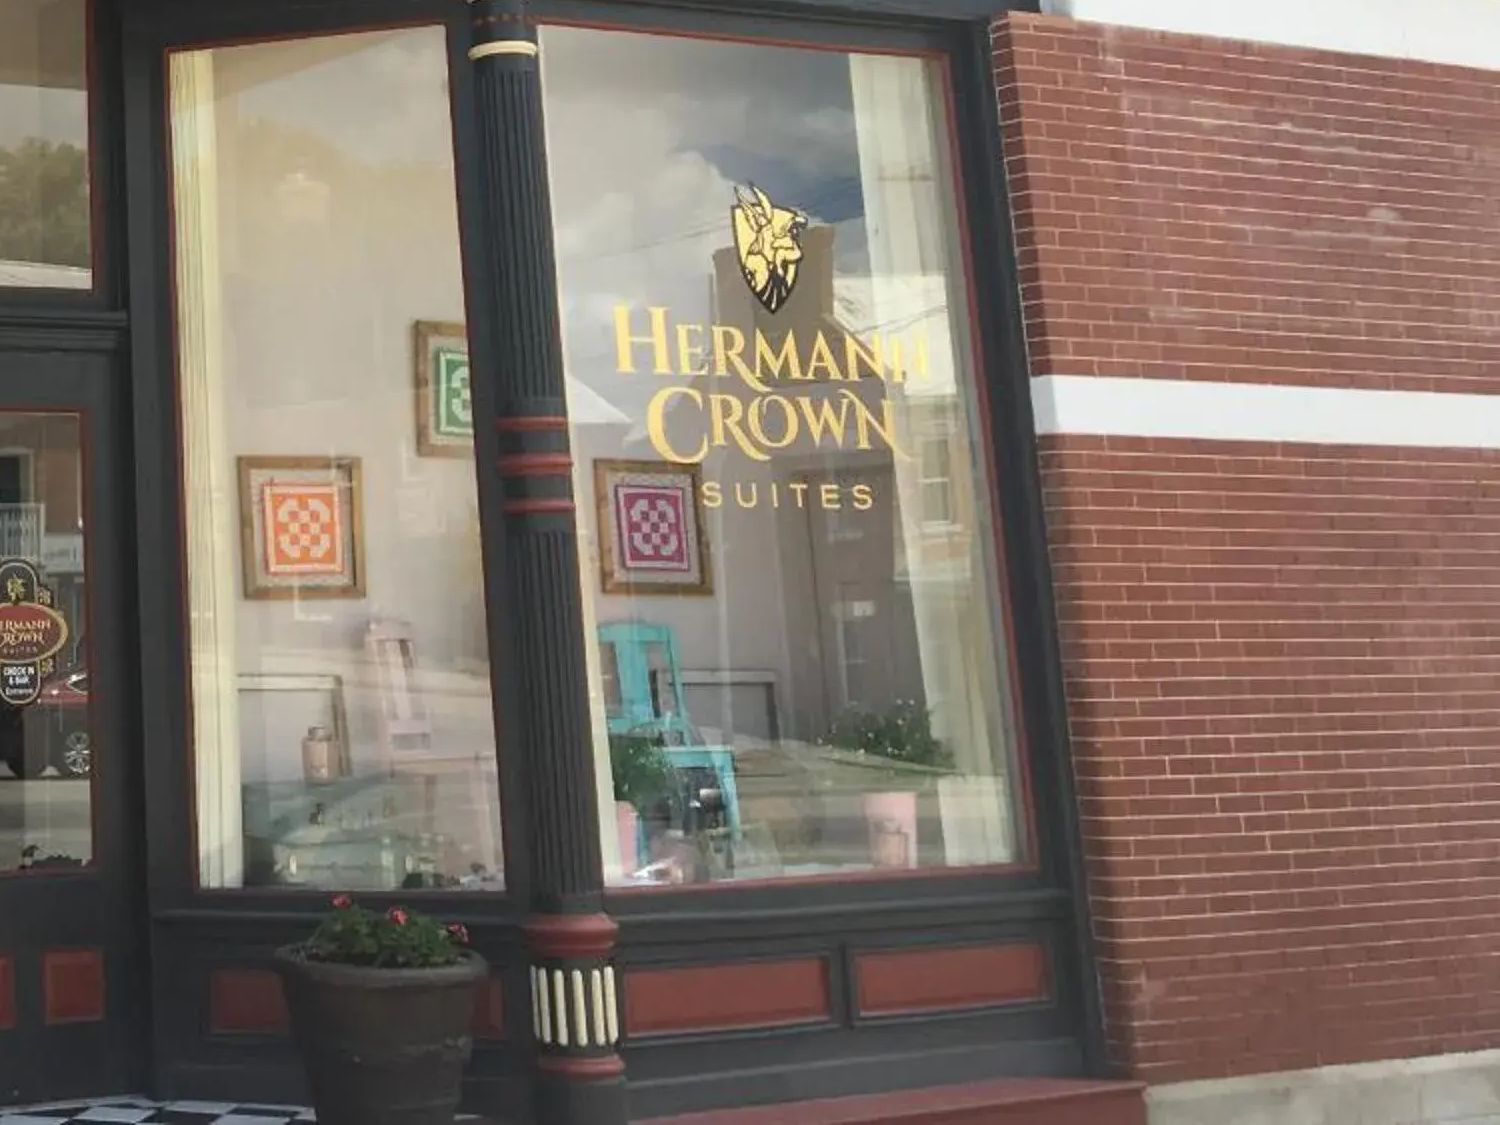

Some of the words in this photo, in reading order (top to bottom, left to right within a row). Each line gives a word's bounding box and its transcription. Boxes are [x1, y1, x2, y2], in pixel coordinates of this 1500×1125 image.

[613, 301, 930, 394] HERMANN
[645, 387, 914, 464] CROWN
[702, 481, 873, 510] SUITES
